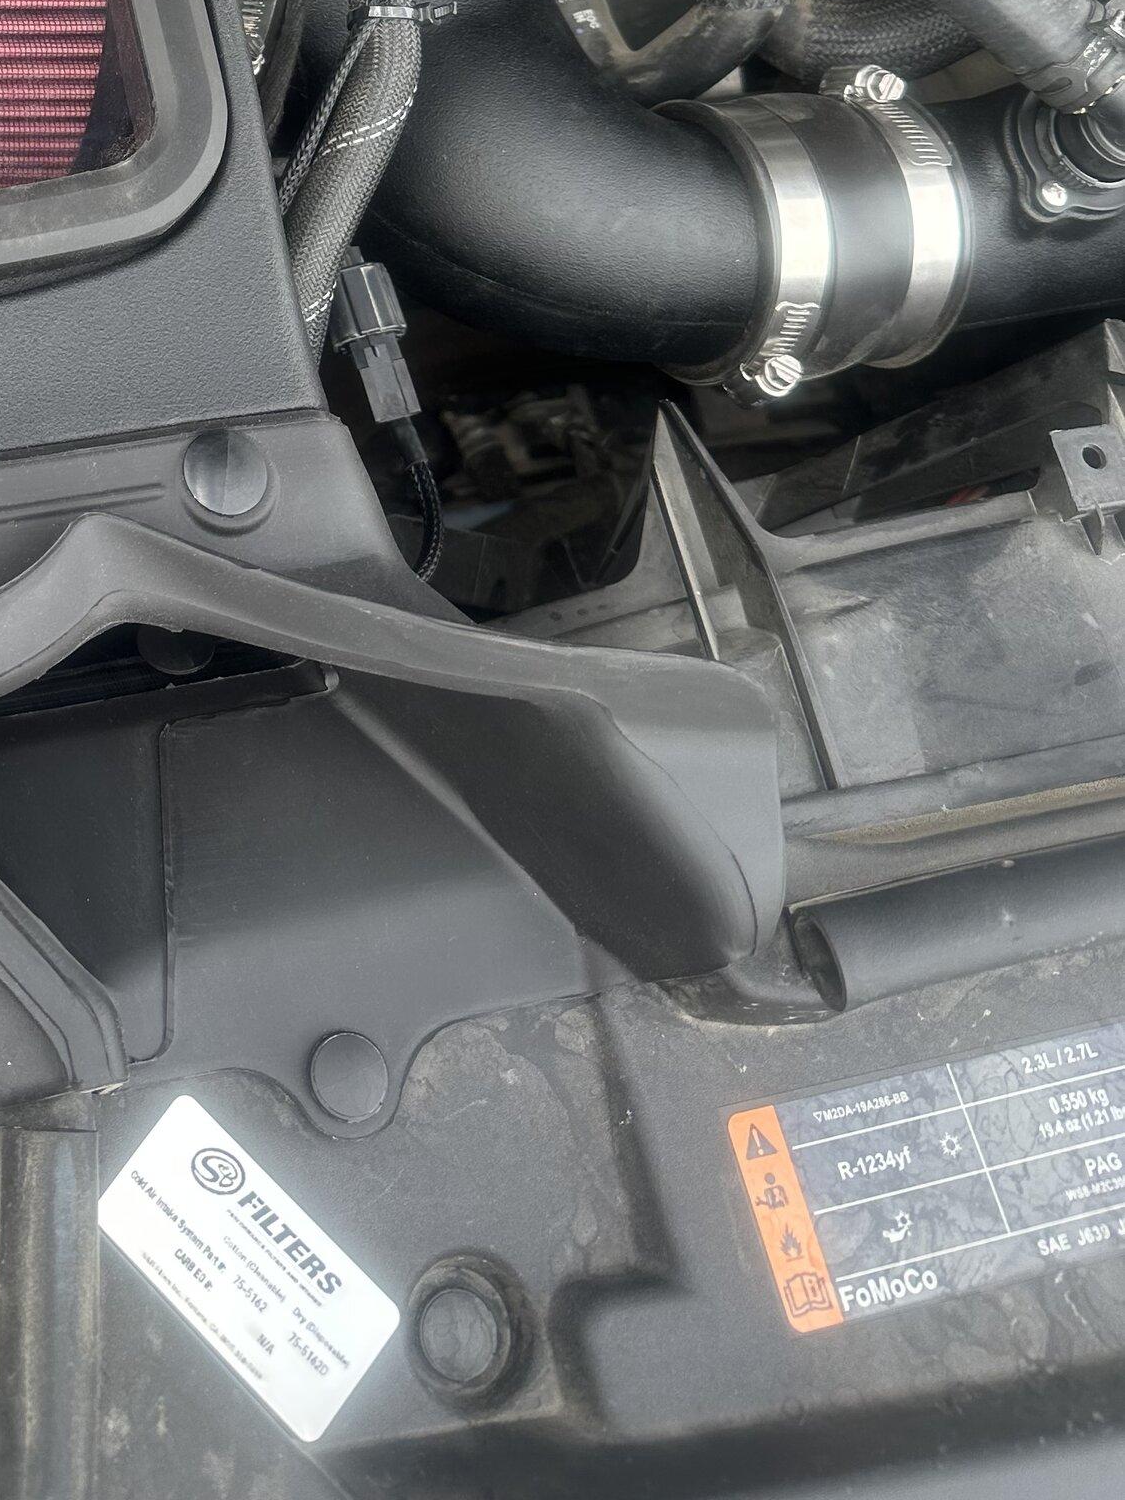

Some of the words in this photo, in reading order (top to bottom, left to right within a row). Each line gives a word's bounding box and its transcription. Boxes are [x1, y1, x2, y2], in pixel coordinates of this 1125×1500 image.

[1021, 1052, 1056, 1074] 2.3L
[1063, 1042, 1099, 1064] 2.7L
[1048, 1090, 1088, 1115] 0.550
[1087, 1087, 1111, 1107] kg
[1038, 1119, 1065, 1139] 19.4
[1065, 1117, 1082, 1133] oz
[1081, 1107, 1110, 1132] (1.21
[837, 1145, 913, 1181] R-1234yf
[1084, 1152, 1123, 1178] PAG
[130, 1169, 149, 1191] Cold
[145, 1186, 157, 1200] Air
[177, 1219, 204, 1251] System
[202, 1245, 220, 1266] Part
[237, 1191, 343, 1295] FILTERS
[1037, 1233, 1073, 1257] SAE
[174, 1247, 196, 1272] CARB
[233, 1274, 268, 1313] 75-5162
[838, 1268, 938, 1313] FoMoCo
[292, 1306, 307, 1325] Dry
[256, 1332, 276, 1355] N/A
